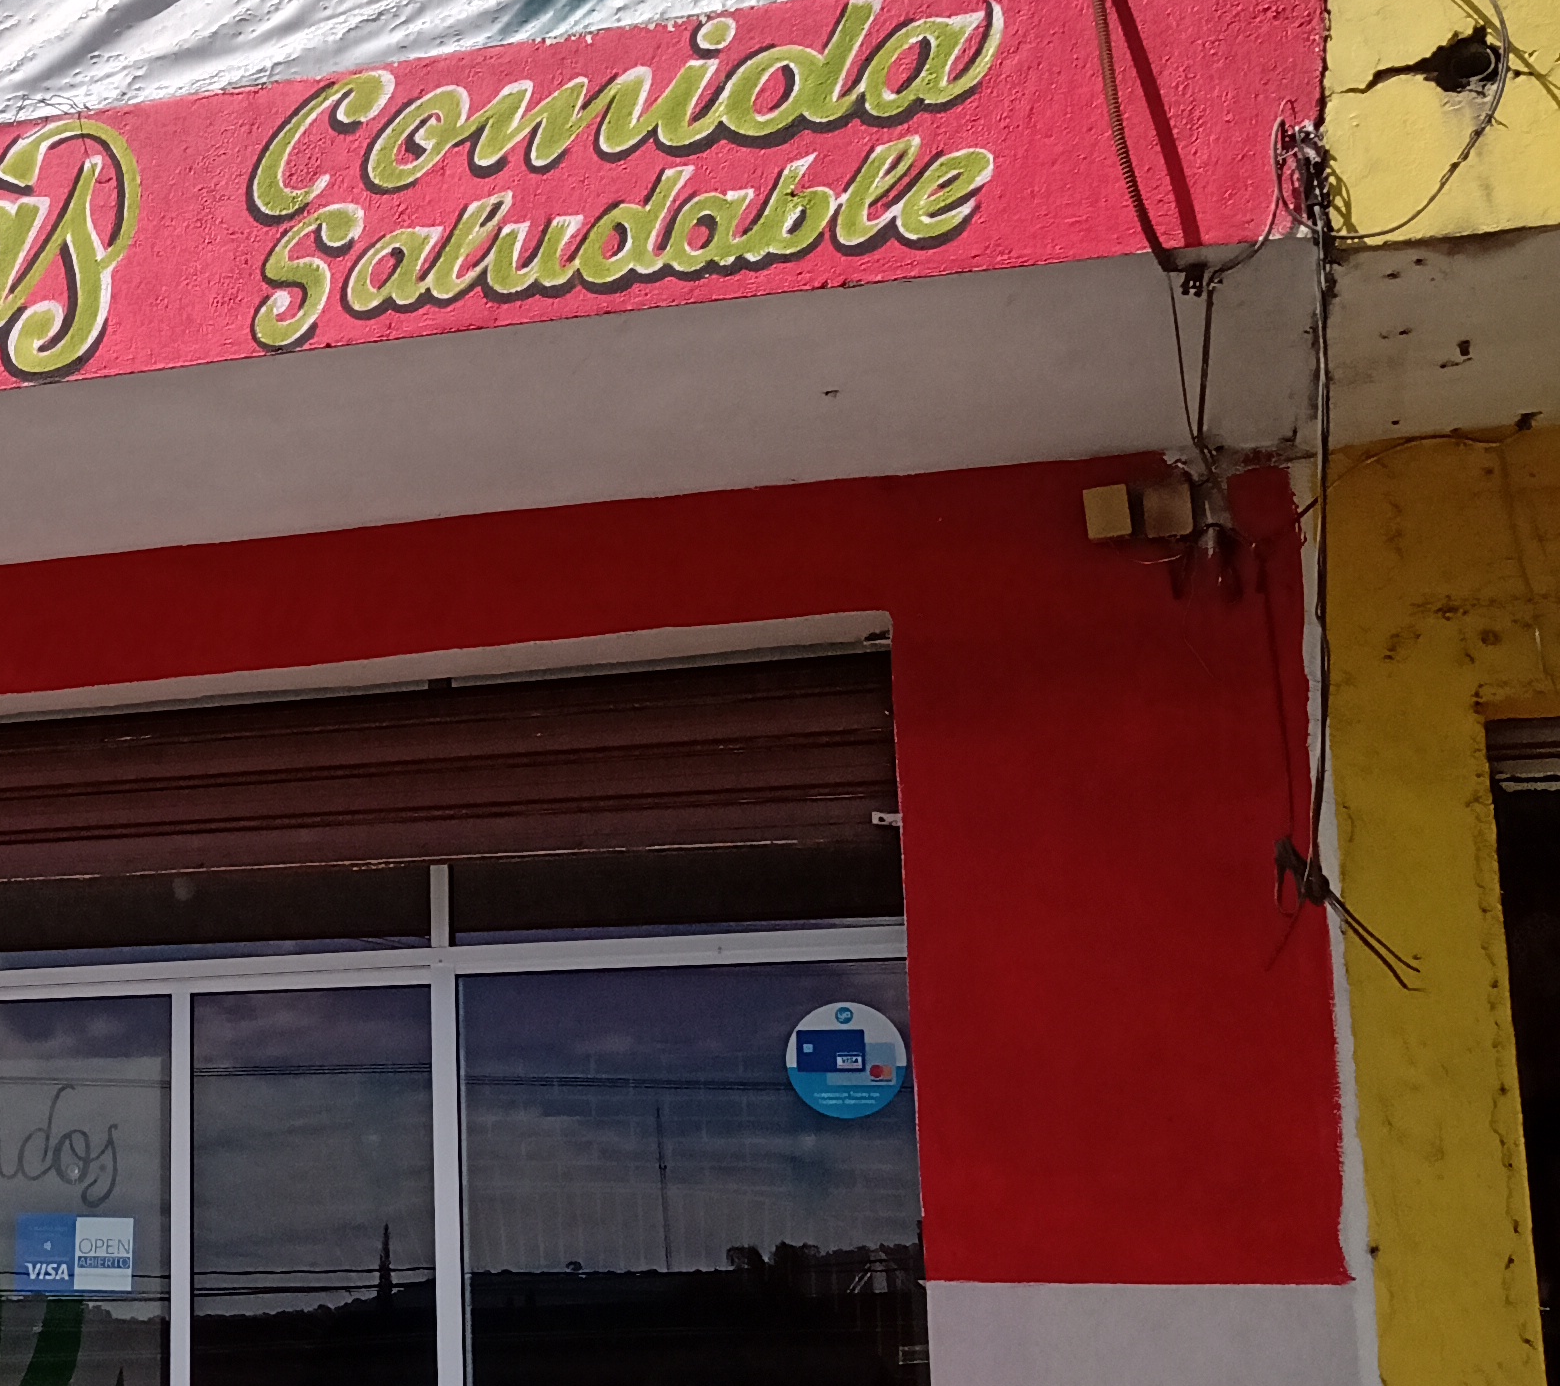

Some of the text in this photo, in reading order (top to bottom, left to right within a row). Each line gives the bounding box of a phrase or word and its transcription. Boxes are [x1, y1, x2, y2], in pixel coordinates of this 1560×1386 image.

[251, 134, 994, 351] Saludable
[78, 1237, 131, 1254] OPEN
[24, 1262, 69, 1281] VISA
[79, 1257, 130, 1268] ABIERTO
